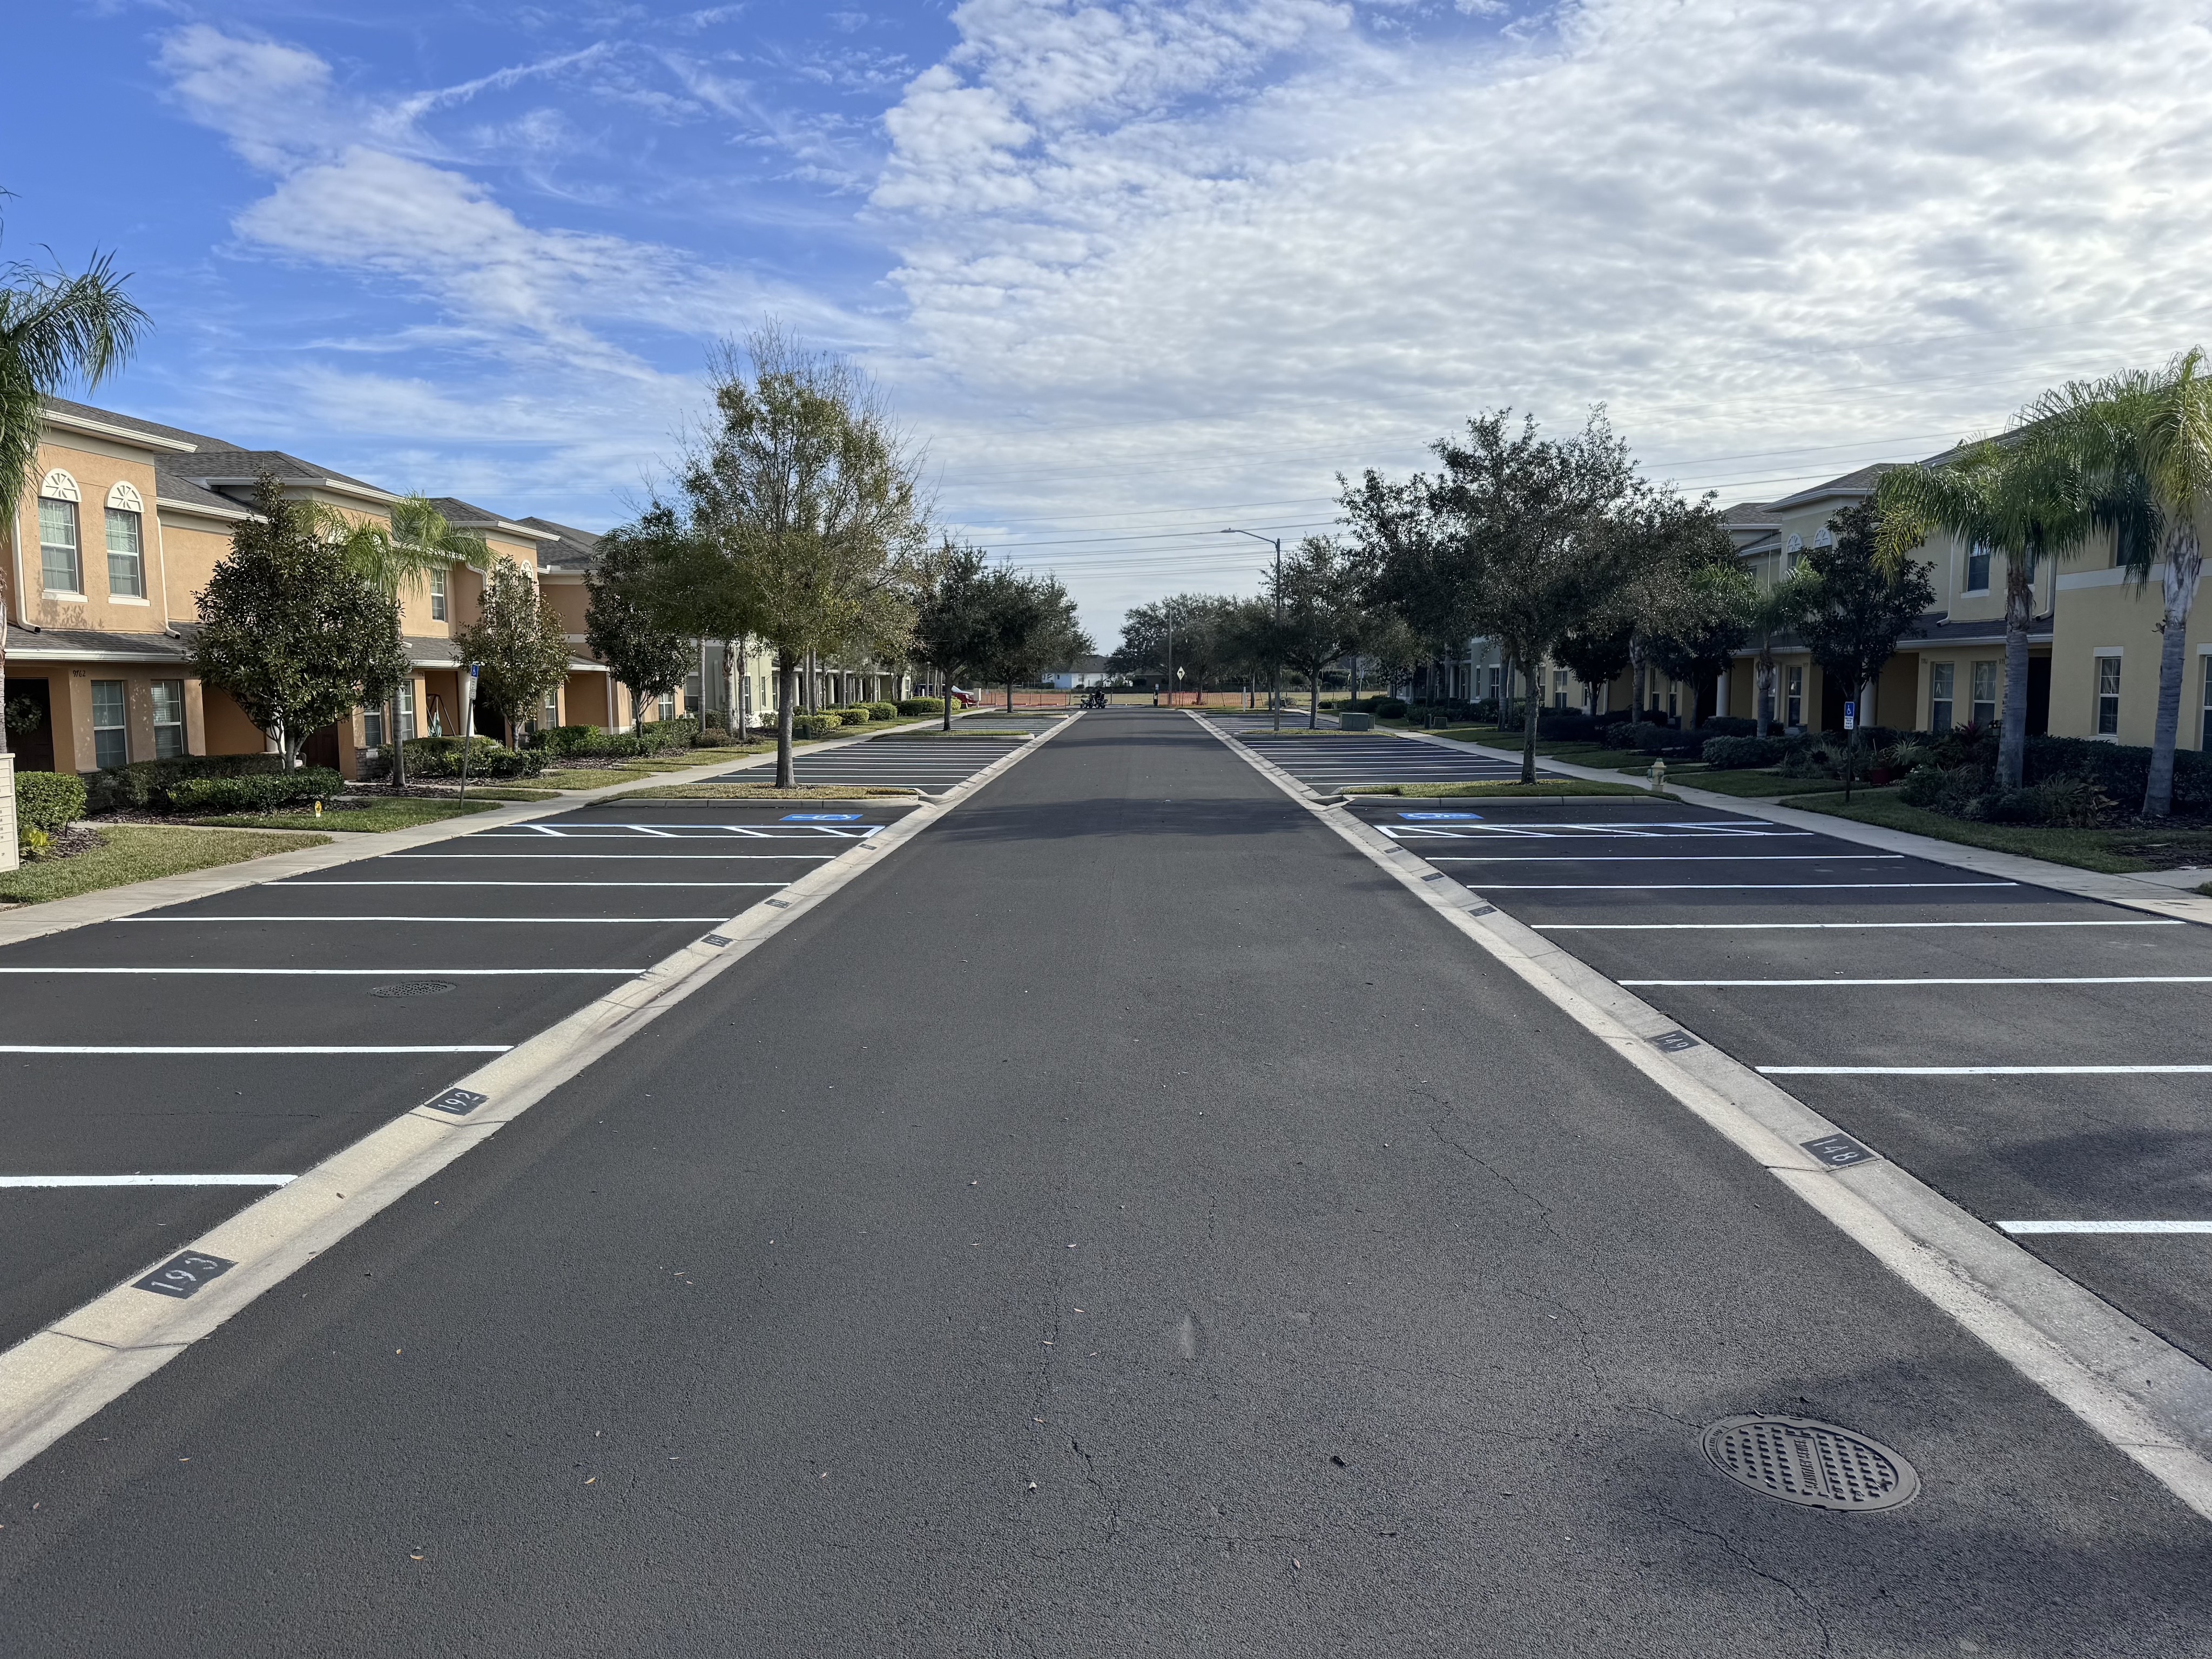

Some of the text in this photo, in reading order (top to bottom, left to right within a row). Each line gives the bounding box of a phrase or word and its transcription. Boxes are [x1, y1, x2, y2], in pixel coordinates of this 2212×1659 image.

[72, 670, 86, 678] 9762
[707, 936, 728, 945] 191
[1656, 1034, 1689, 1048] 149
[437, 1092, 480, 1111] 192
[1812, 1138, 1859, 1161] 148
[151, 1257, 218, 1292] 193
[1793, 1439, 1819, 1489] SANITARY SEWER
